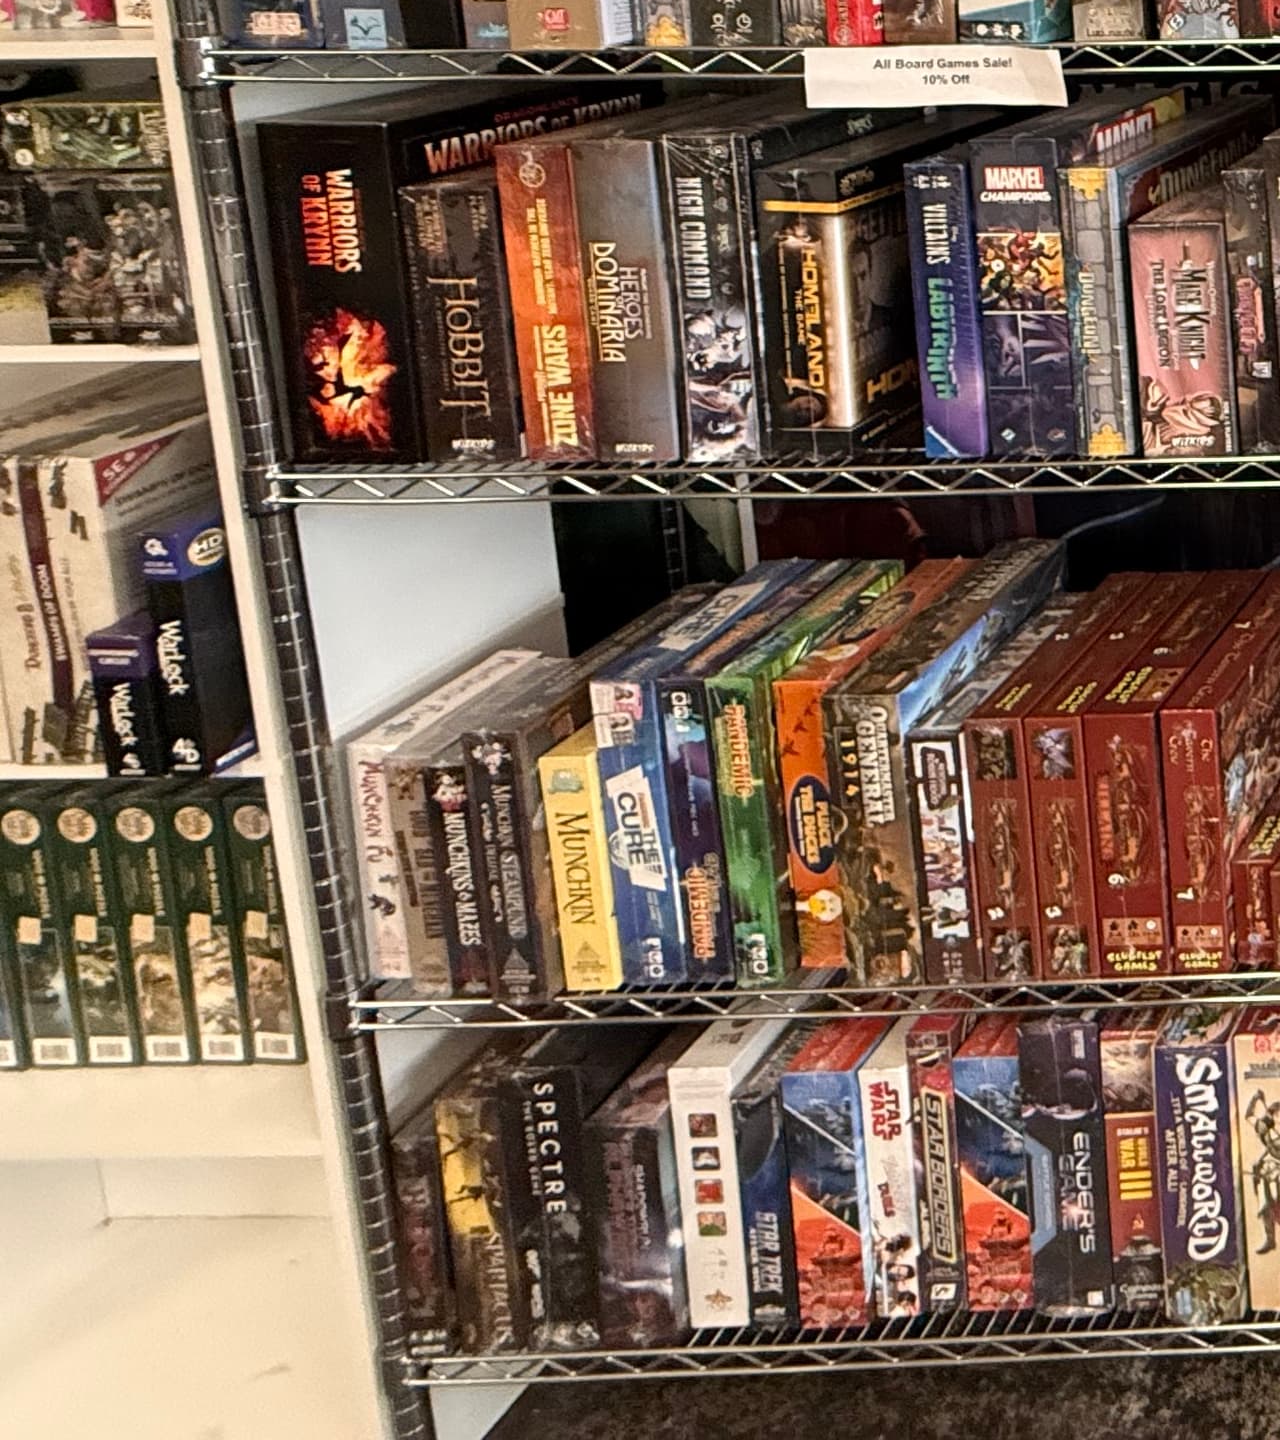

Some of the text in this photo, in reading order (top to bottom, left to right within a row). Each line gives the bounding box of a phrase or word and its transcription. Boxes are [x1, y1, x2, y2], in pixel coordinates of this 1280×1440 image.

[874, 57, 1012, 71] All Board Games Sale!
[922, 73, 970, 85] 10% Off
[302, 175, 326, 267] OF KRYNN
[325, 169, 362, 272] WARRIORS
[980, 192, 1051, 202] CHAMPIONS
[983, 168, 1044, 189] MARVEL
[676, 177, 711, 300] HIGH COMMAND
[922, 203, 951, 265] VILLAINS
[589, 242, 627, 362] DOMINARIA
[618, 266, 643, 339] HEROES
[803, 246, 826, 389] HOMELAND
[545, 324, 578, 447] ZONE WARS
[724, 705, 754, 796] PANDEMIC
[842, 739, 858, 798] 1914
[555, 811, 598, 925] MUNCHKIN
[614, 792, 647, 875] CURE
[534, 1082, 566, 1214] SPECTRE
